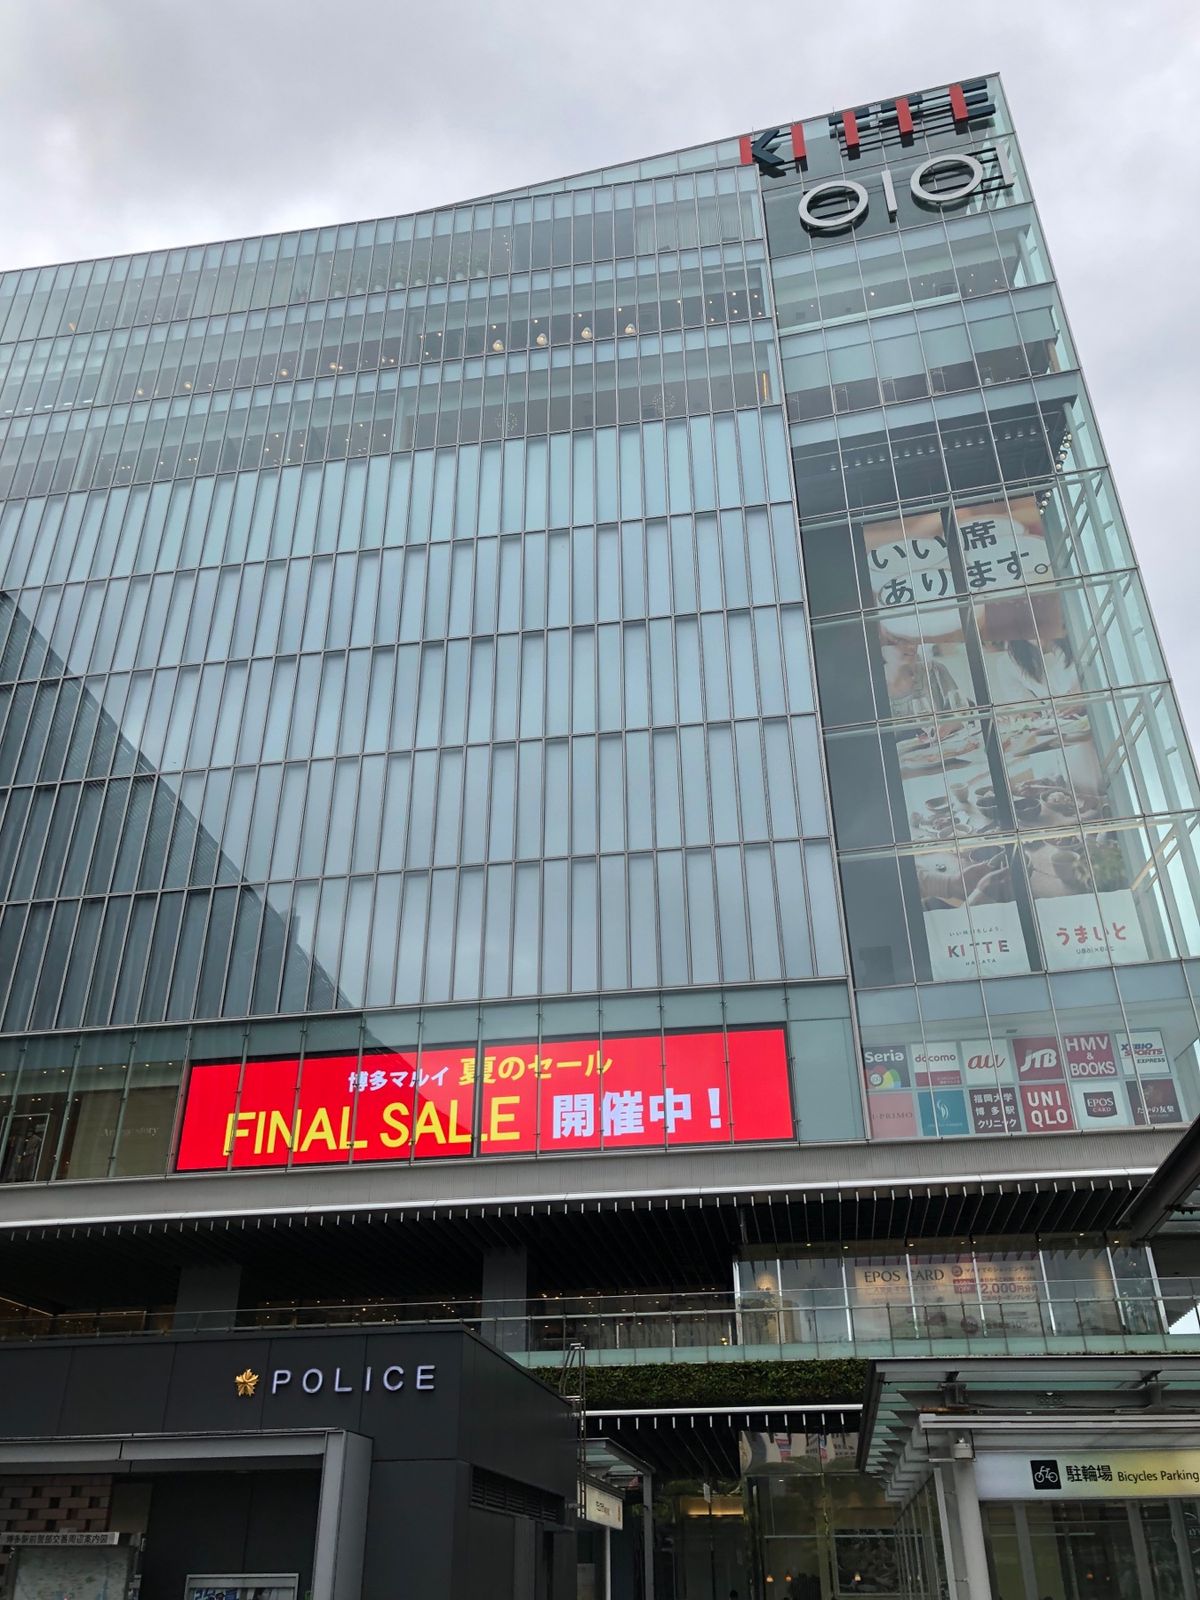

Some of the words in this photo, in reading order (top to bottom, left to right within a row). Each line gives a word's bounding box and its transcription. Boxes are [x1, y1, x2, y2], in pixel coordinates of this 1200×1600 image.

[739, 79, 997, 166] KITTE
[947, 939, 1010, 958] KITTE
[1065, 1036, 1109, 1052] HMV
[864, 1050, 905, 1063] Seria
[915, 1054, 957, 1063] docomo
[967, 1053, 1006, 1070] au
[1020, 1048, 1057, 1073] JTB
[348, 1067, 449, 1093] 博多マルイ
[459, 1050, 613, 1086] 夏のセール
[1070, 1061, 1116, 1077] BOOKS
[1027, 1090, 1062, 1107] UNI
[1087, 1097, 1114, 1108] EPOS
[222, 1106, 368, 1156] FINAL
[380, 1094, 520, 1149] SALE
[1031, 1109, 1068, 1128] QLO
[864, 1270, 901, 1283] EPOS
[906, 1269, 945, 1282] CARD
[271, 1364, 436, 1395] POLICE
[1065, 1465, 1113, 1482] 駐輪場
[1117, 1470, 1158, 1483] Bicycles
[1161, 1469, 1199, 1483] Parking
